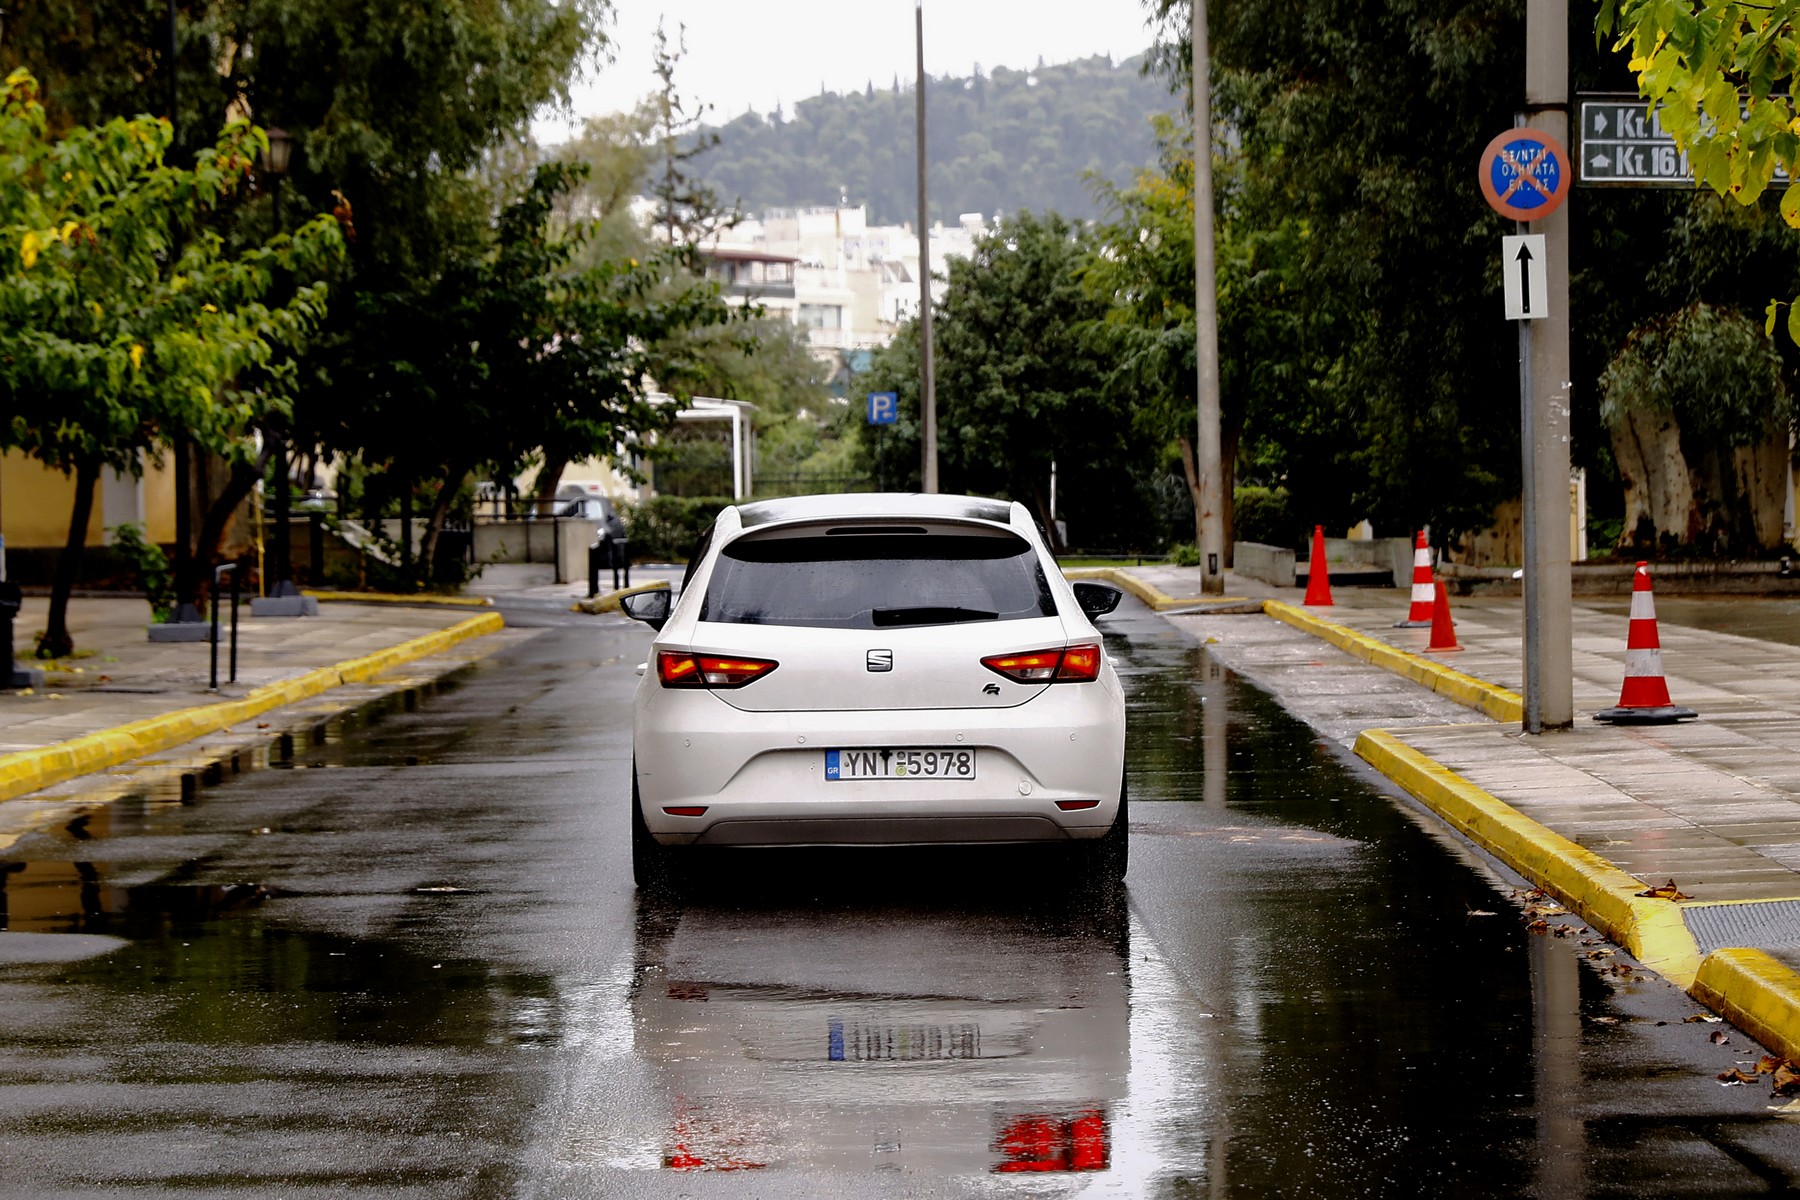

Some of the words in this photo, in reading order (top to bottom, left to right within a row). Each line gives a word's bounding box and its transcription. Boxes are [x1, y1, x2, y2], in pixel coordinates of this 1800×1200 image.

[873, 396, 891, 420] P
[982, 683, 1001, 696] FR
[827, 767, 839, 775] GR
